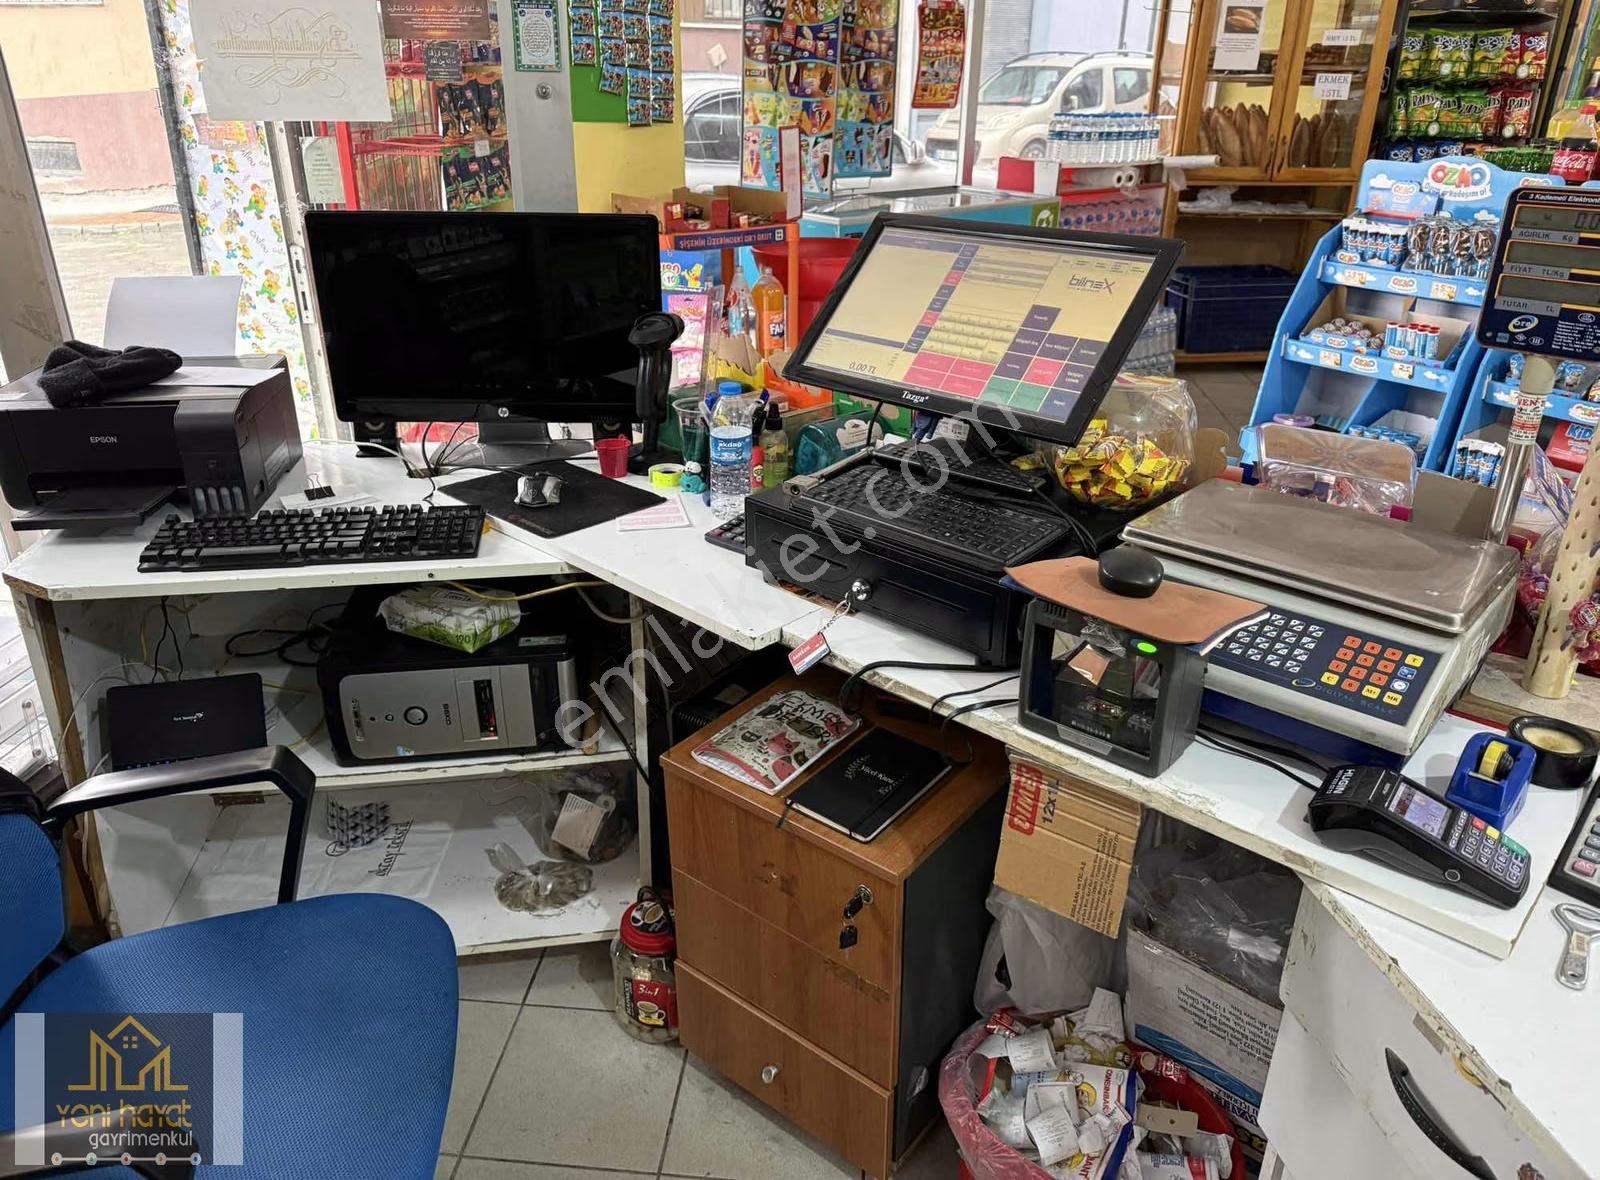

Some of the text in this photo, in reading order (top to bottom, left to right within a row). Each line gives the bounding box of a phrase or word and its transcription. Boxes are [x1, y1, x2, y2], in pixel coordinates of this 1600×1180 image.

[1318, 75, 1350, 85] EKMEK
[848, 361, 867, 373] 0.00
[90, 436, 118, 444] EPSON
[1333, 768, 1356, 795] HUGIN
[1577, 859, 1593, 869] AC
